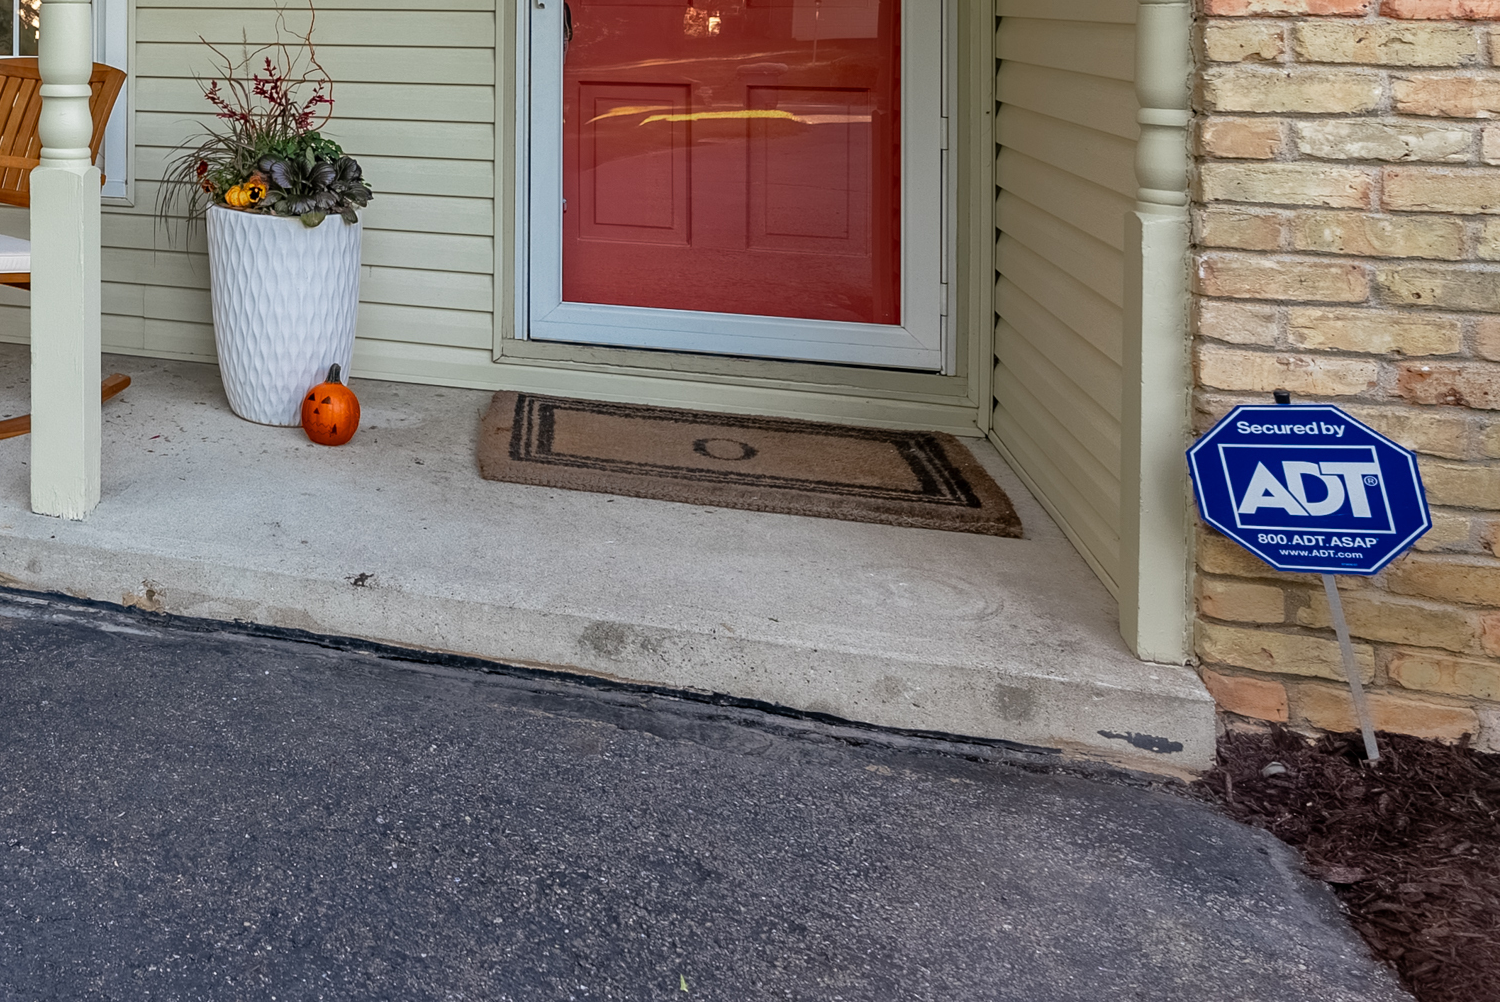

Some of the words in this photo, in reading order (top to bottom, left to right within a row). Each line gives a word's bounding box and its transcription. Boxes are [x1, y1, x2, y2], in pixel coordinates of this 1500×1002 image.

[1236, 421, 1318, 435] Secured
[1321, 422, 1345, 437] by
[1257, 533, 1377, 548] 800.ADT.ASAP
[1279, 549, 1364, 559] www.ADT.com
